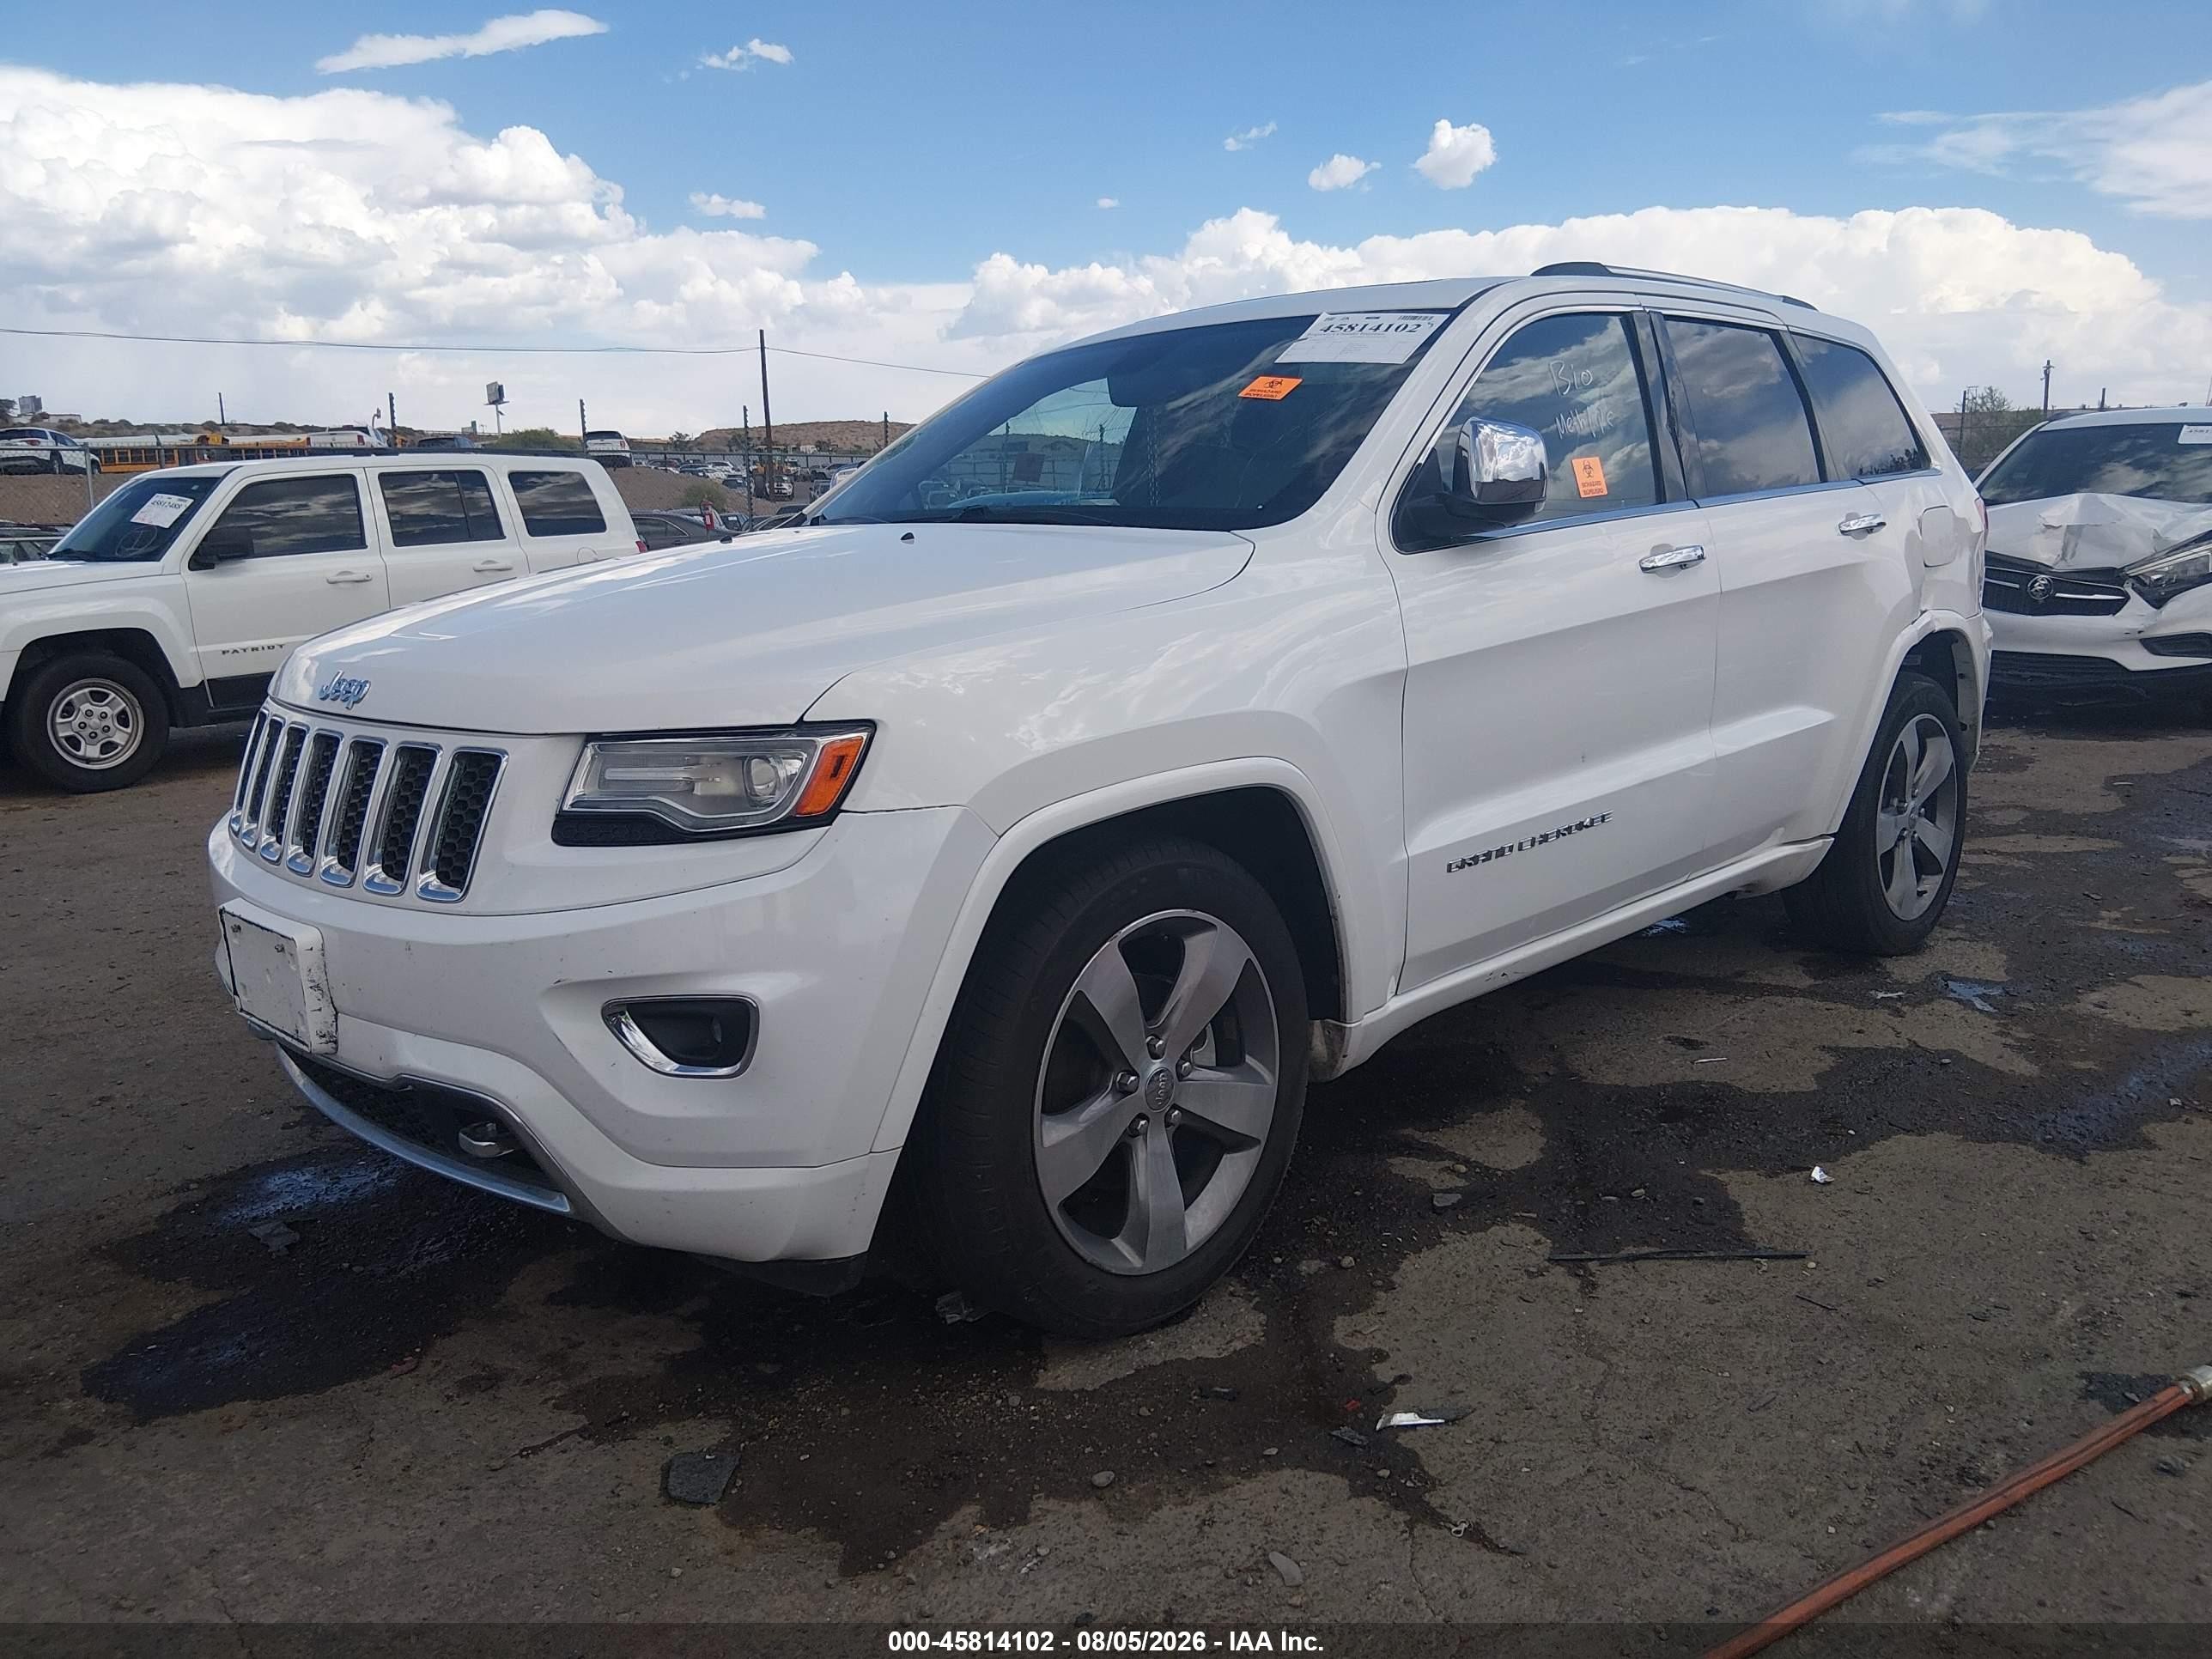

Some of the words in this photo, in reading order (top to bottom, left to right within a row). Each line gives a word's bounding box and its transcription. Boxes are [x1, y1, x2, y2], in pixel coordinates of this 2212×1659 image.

[1319, 321, 1423, 334] 45814102
[1549, 360, 1593, 396] Bio
[221, 643, 286, 655] PATRIOT
[318, 669, 372, 711] Jeep
[1446, 842, 1515, 873] GRAND
[1517, 809, 1614, 852] CHEROKEE
